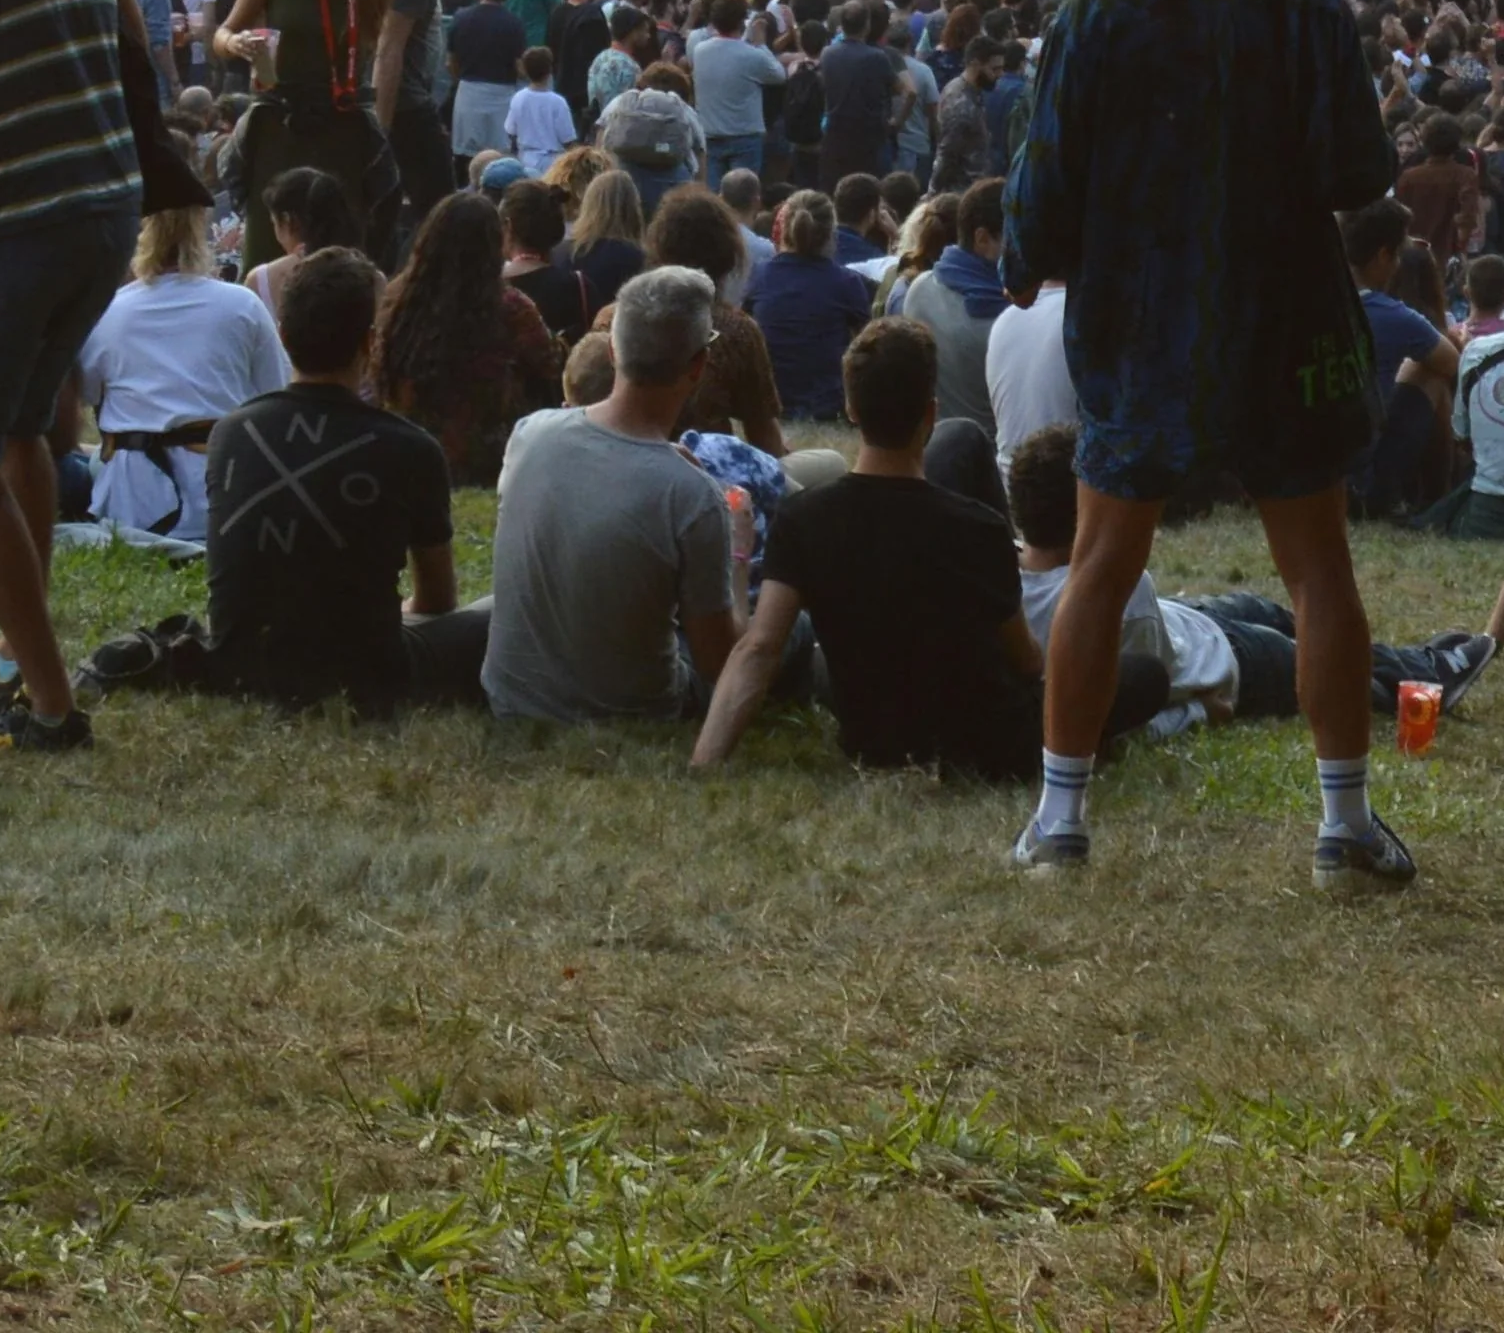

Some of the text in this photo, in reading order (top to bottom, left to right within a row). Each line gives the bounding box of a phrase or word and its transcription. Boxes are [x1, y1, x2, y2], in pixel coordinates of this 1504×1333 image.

[285, 411, 328, 445] N
[339, 470, 381, 506] O
[257, 515, 299, 554] N
